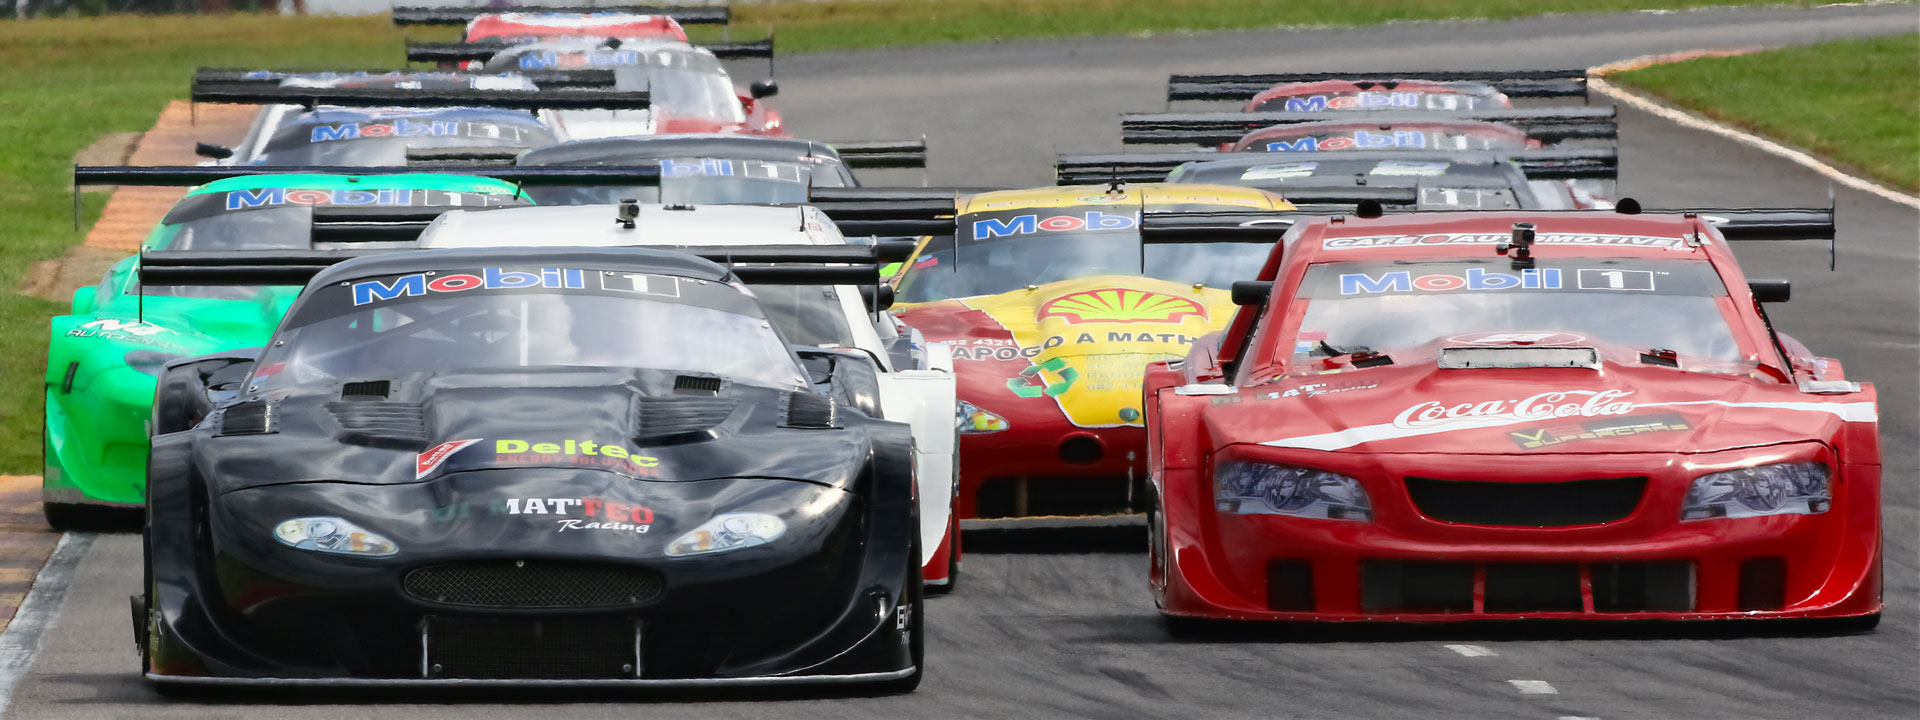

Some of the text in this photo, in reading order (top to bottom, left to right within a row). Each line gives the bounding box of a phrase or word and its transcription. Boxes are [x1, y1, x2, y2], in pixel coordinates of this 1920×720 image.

[519, 51, 639, 70] Mobil
[1285, 91, 1419, 112] Mobil
[311, 119, 459, 143] Mobil
[1266, 130, 1426, 152] Mobil
[660, 158, 735, 177] bil
[226, 187, 413, 211] Mobil
[973, 211, 1144, 241] Mob
[1451, 233, 1677, 248] AUTMOTIVE
[353, 267, 585, 307] Mobil
[1339, 267, 1562, 296] Mobil
[1075, 332, 1103, 345] A
[1393, 388, 1636, 430] Coca-Cola
[1523, 424, 1690, 450] SUPERCARS
[496, 439, 660, 468] Deltec
[557, 519, 650, 534] Racing
